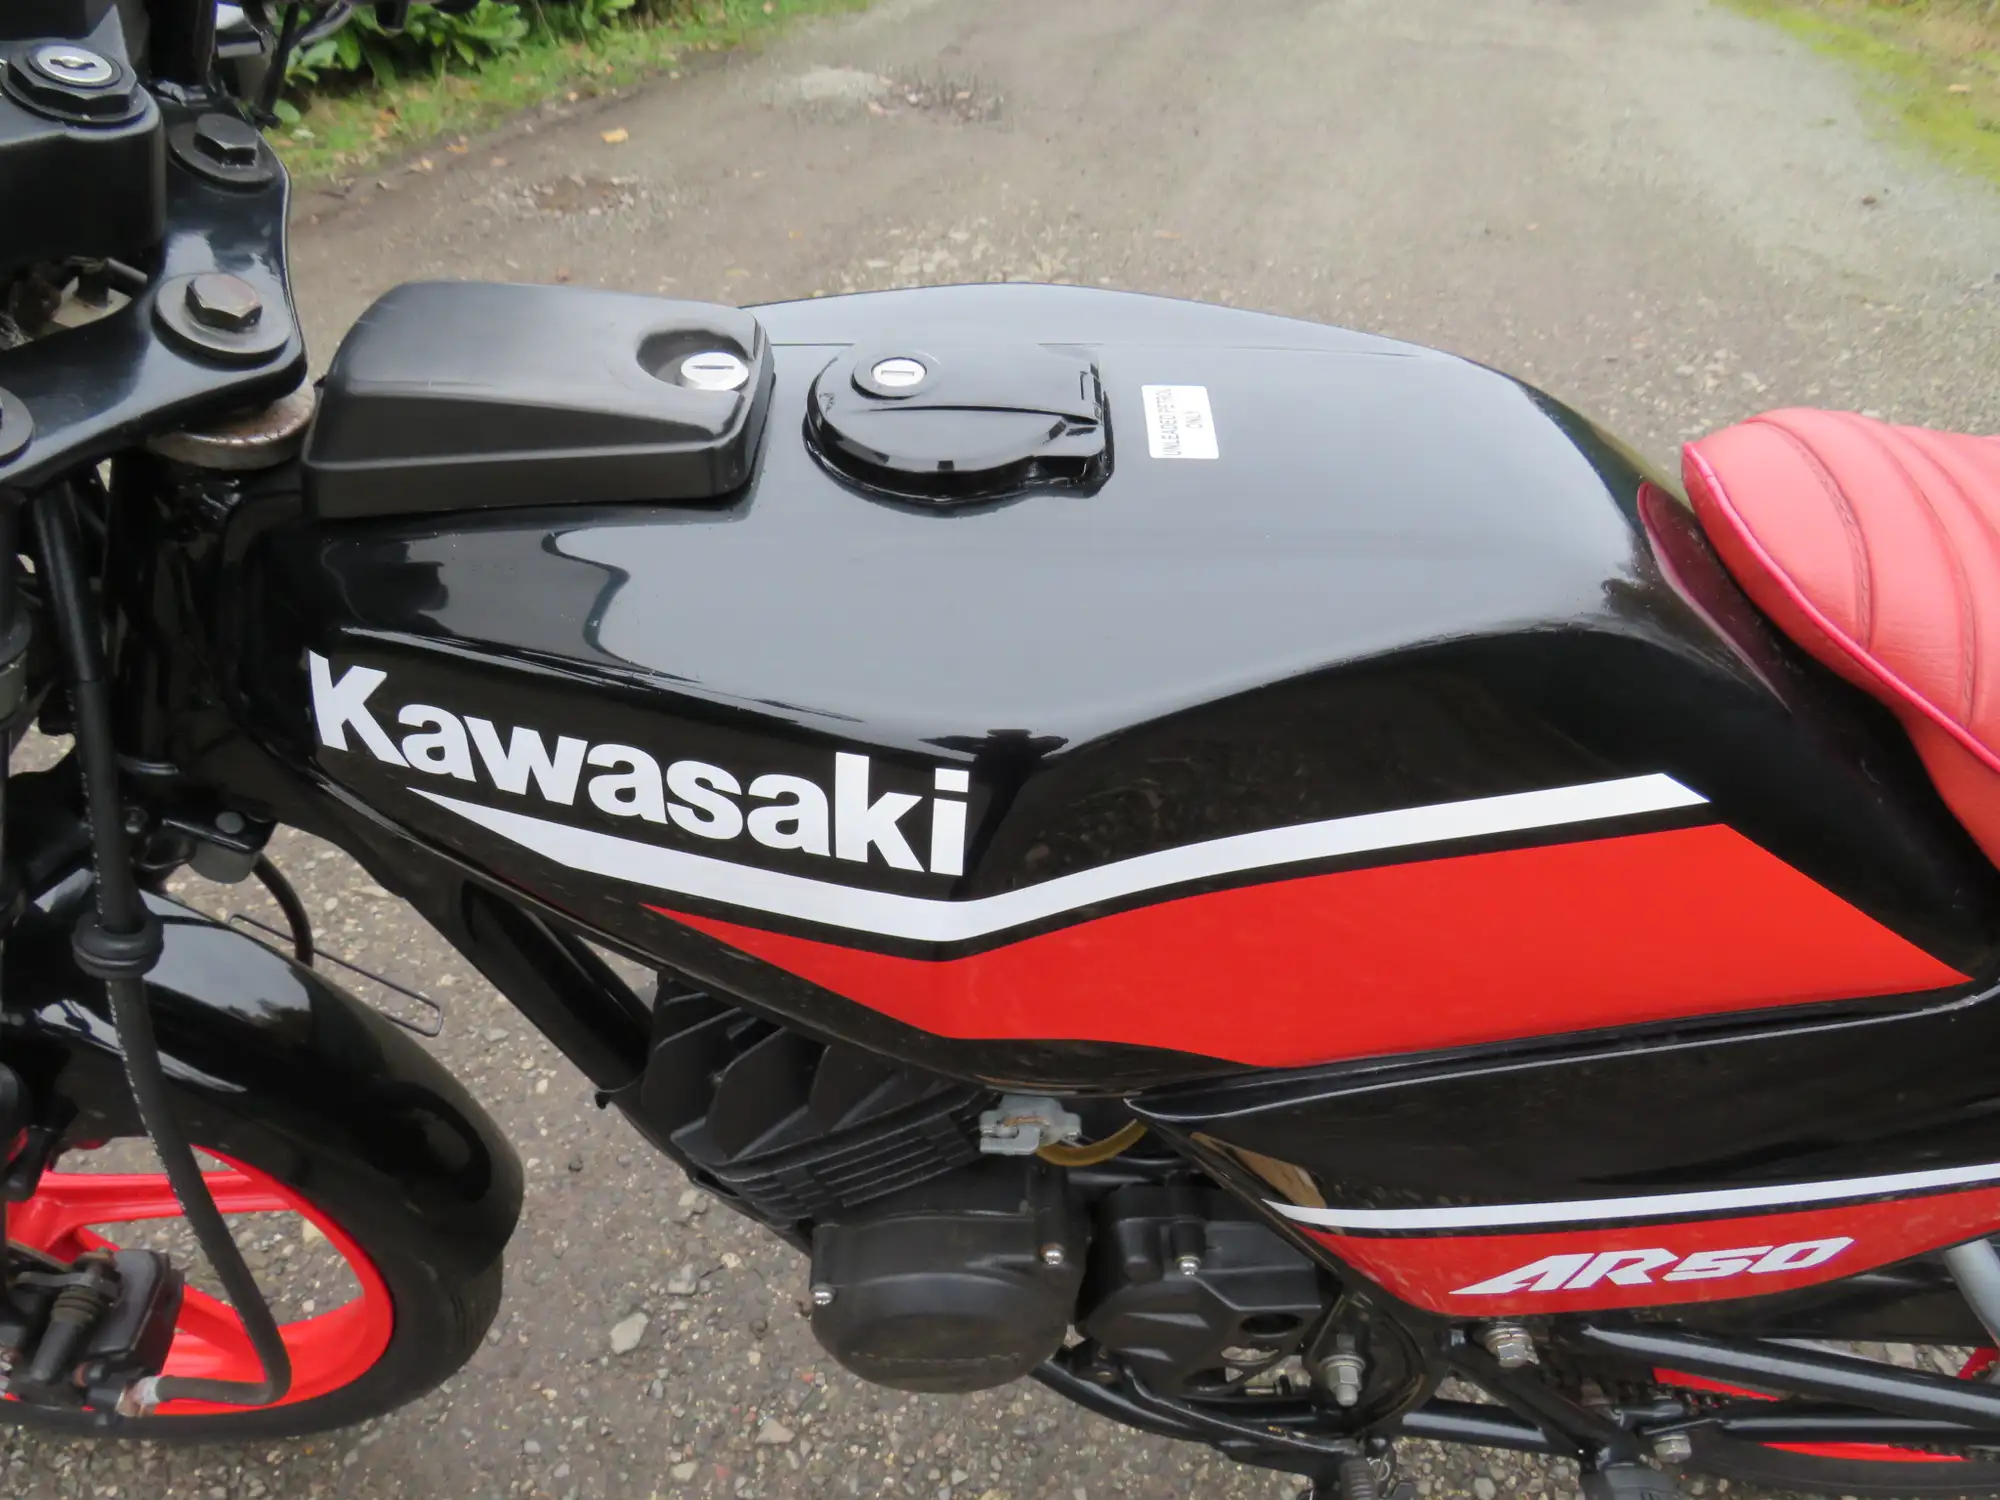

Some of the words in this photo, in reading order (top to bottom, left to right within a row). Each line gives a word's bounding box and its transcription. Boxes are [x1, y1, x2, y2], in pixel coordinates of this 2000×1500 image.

[1155, 388, 1175, 413] PETROL
[1182, 411, 1203, 429] ONLY
[1159, 415, 1182, 456] UNLEADED
[309, 651, 969, 877] Kawasaki
[1448, 1236, 1855, 1294] AR50
